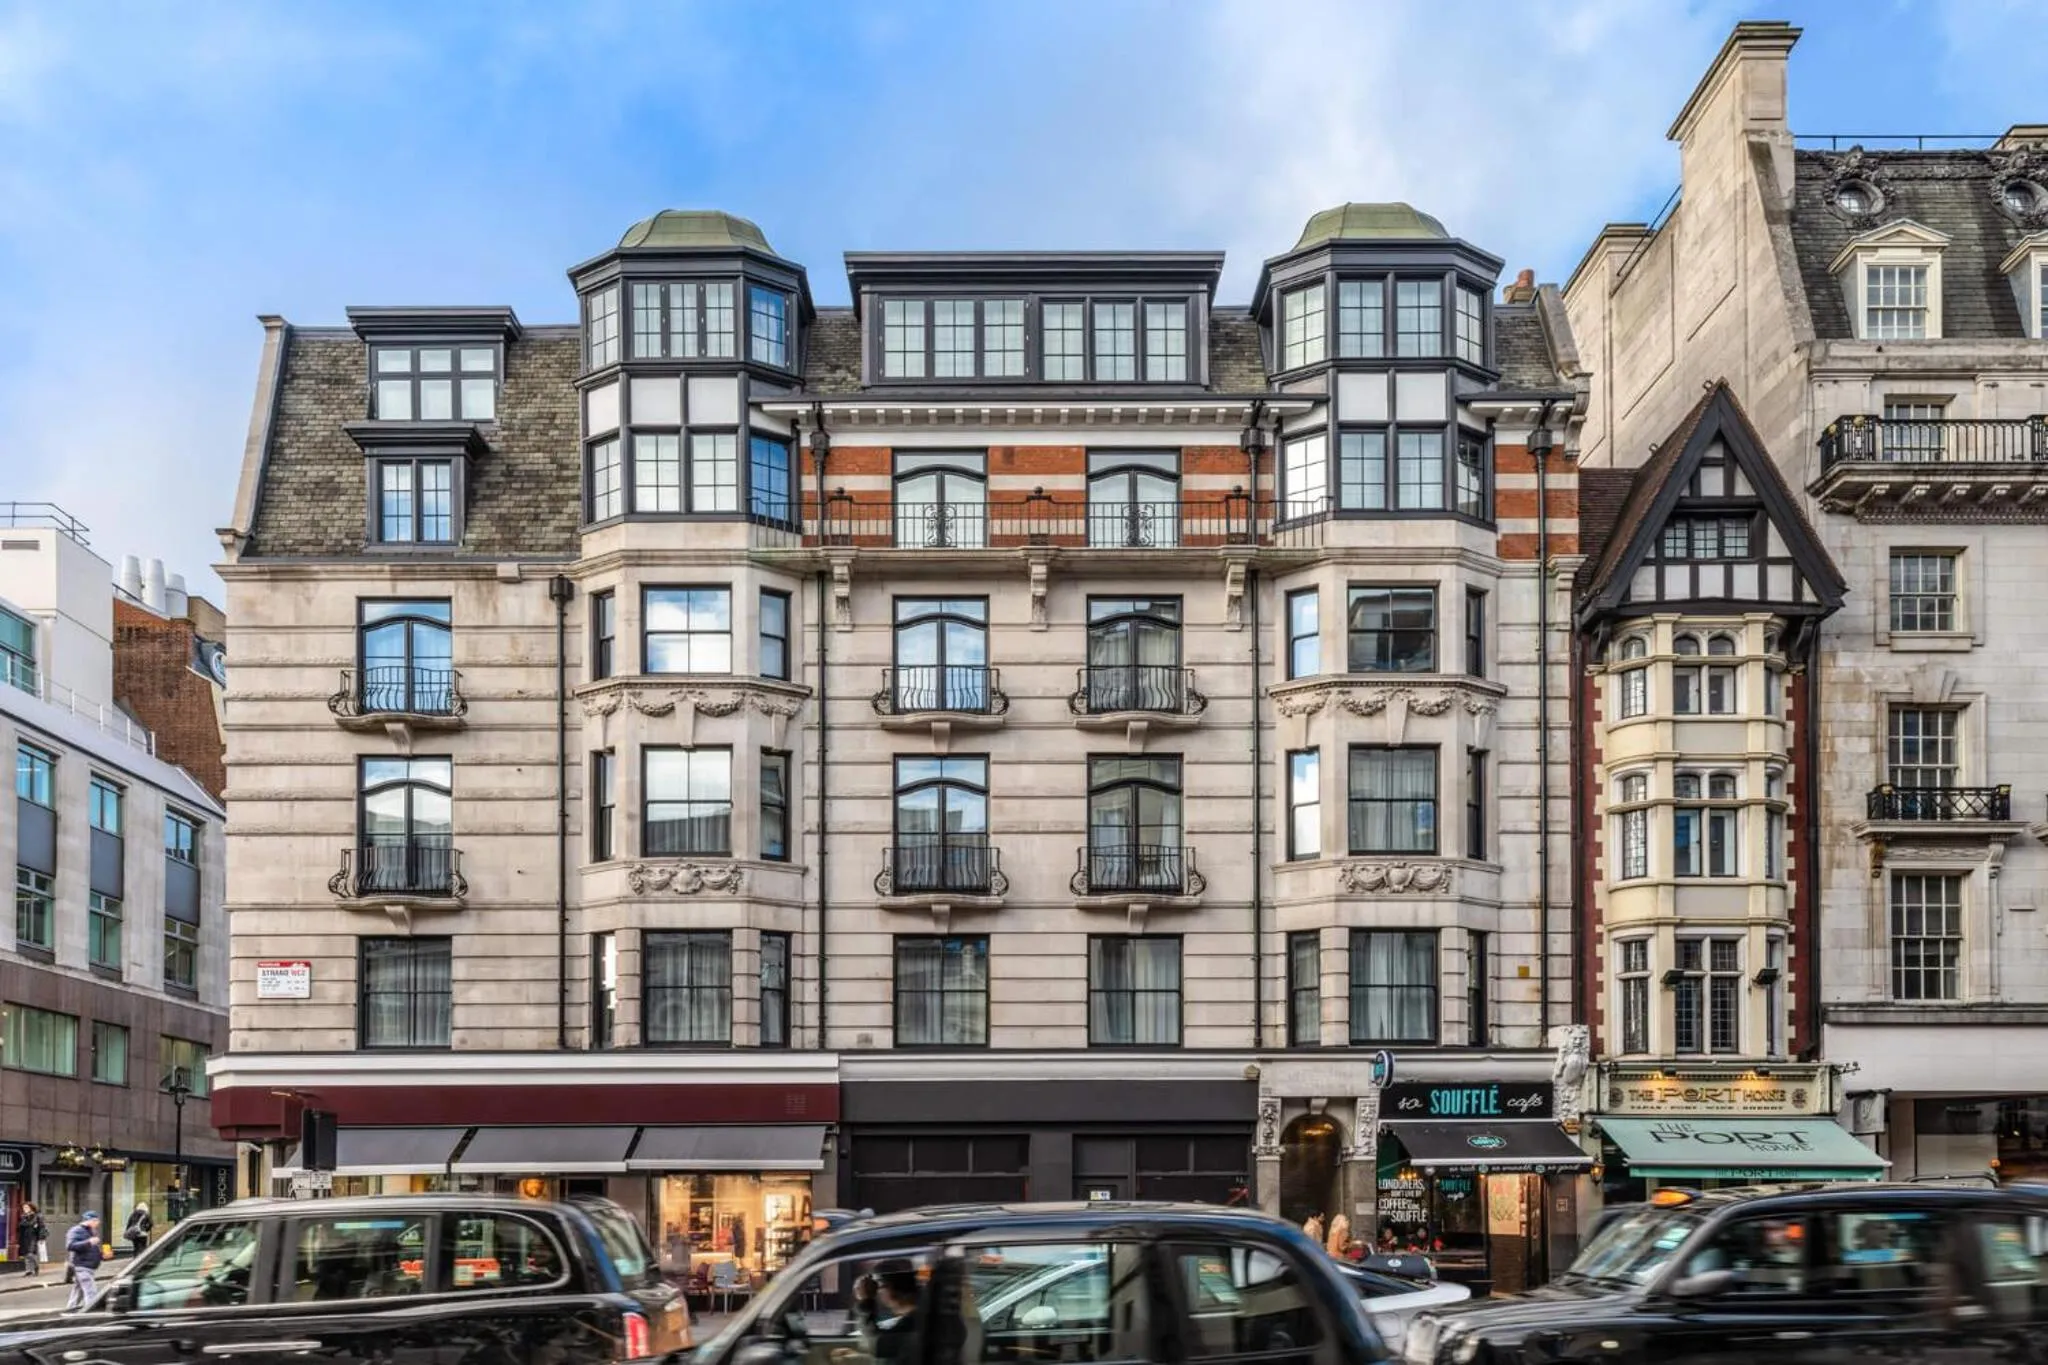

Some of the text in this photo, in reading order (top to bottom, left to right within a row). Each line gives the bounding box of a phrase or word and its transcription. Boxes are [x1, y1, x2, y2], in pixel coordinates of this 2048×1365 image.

[1628, 1087, 1786, 1103] THE PORT HOUSE
[1654, 1122, 1694, 1132] THE
[1650, 1131, 1809, 1144] PORT
